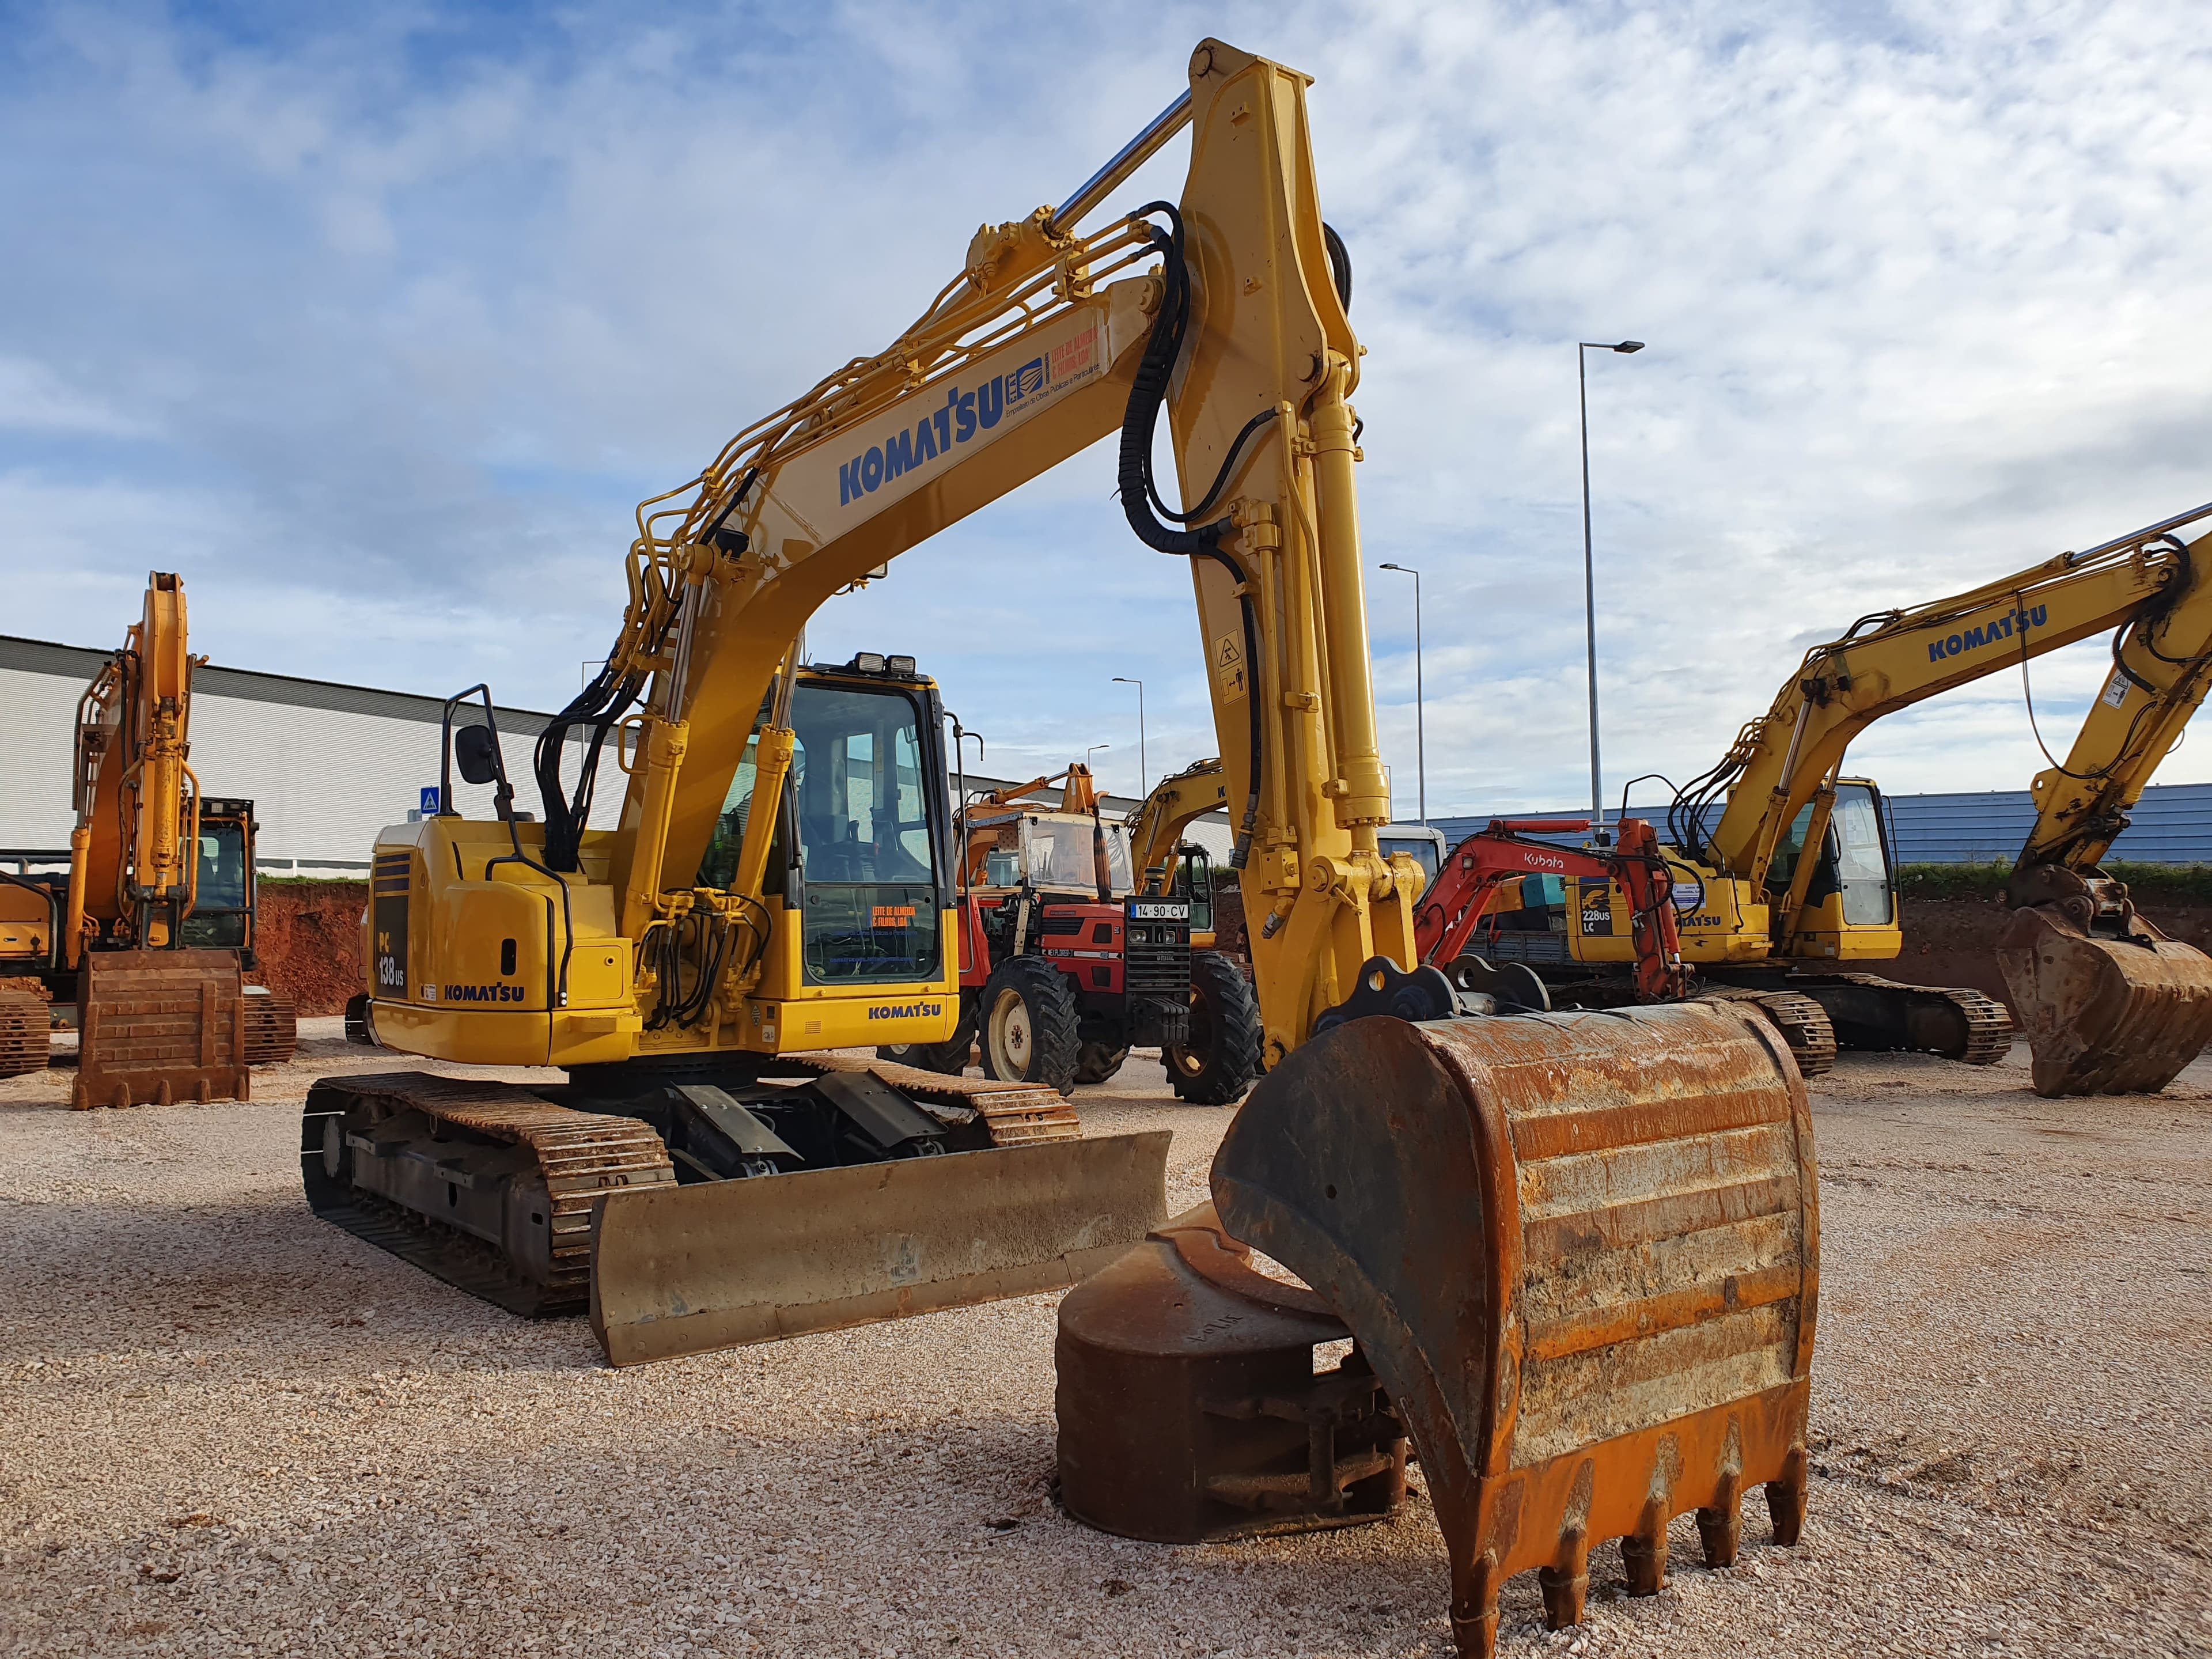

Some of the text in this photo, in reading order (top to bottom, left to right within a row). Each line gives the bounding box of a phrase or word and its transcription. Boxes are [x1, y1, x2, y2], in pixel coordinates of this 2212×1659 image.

[839, 374, 1003, 507] KOMATSU
[1927, 604, 2047, 662] KOMATSU
[1524, 853, 1563, 868] Kubota
[873, 906, 916, 916] LEITE DE ALMEIDA
[897, 917, 907, 927] LDA
[1584, 922, 1594, 932] LC
[379, 932, 389, 953] PC
[445, 982, 524, 1002] KOMATSU
[869, 1001, 941, 1019] KOMATSU
